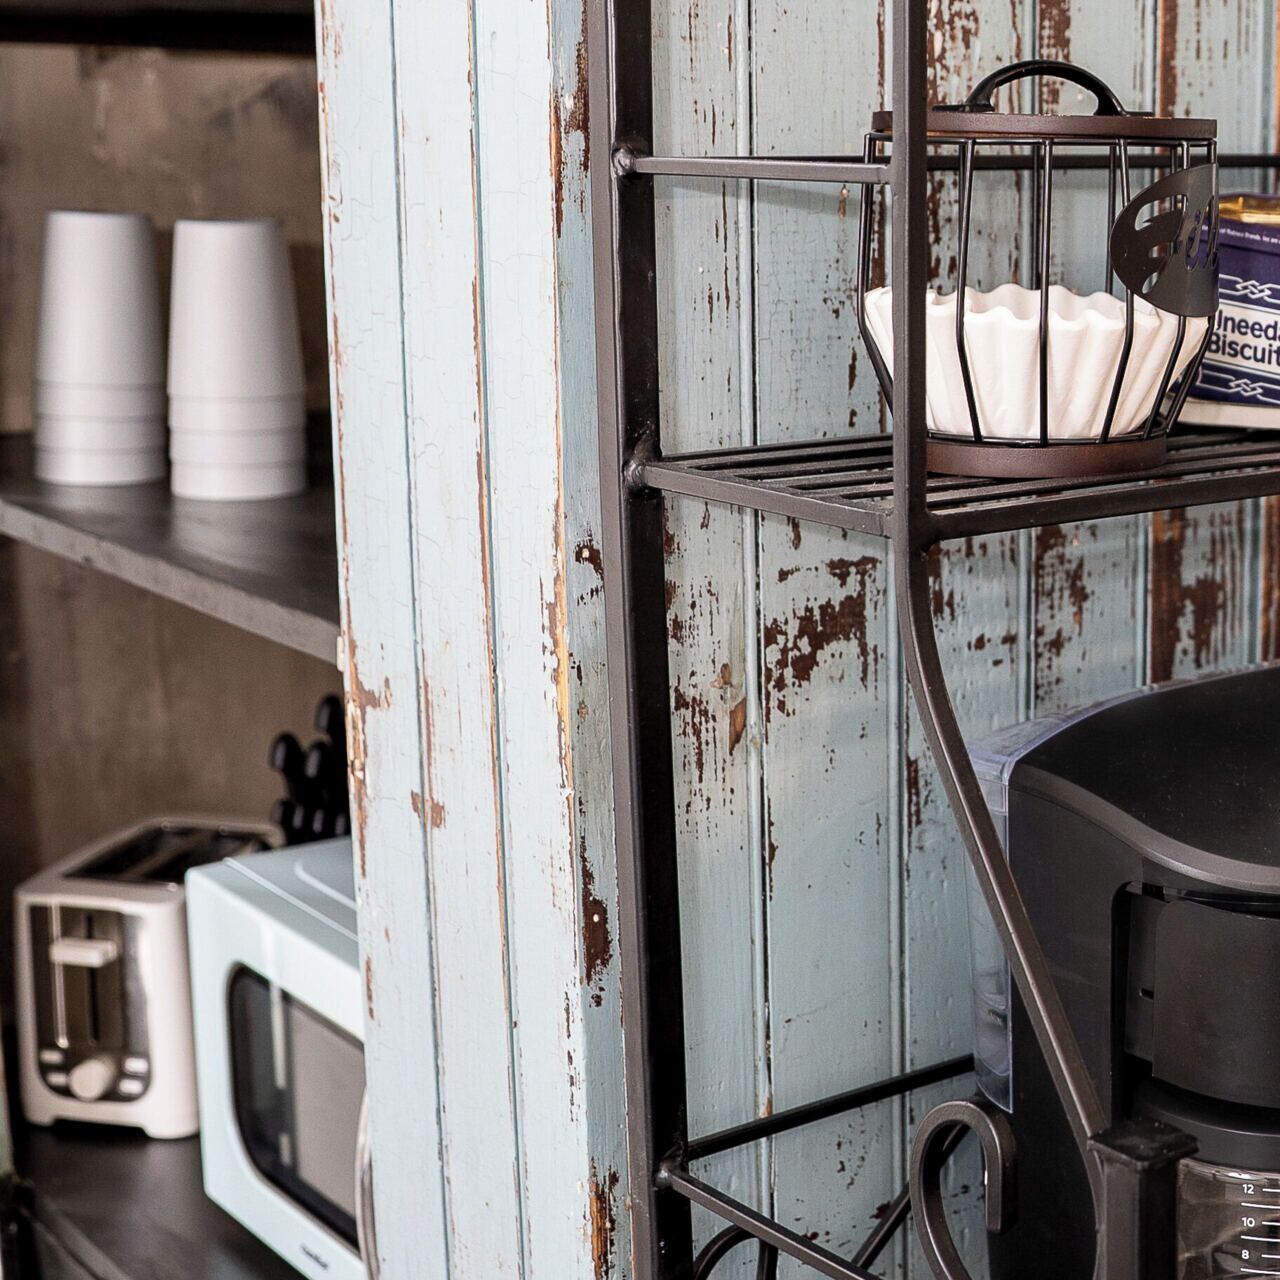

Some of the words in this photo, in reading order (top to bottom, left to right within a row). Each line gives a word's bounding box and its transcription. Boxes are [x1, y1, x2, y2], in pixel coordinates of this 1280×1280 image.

[1242, 1184, 1255, 1195] 12
[1241, 1217, 1256, 1228] 10
[1241, 1249, 1250, 1260] 8
